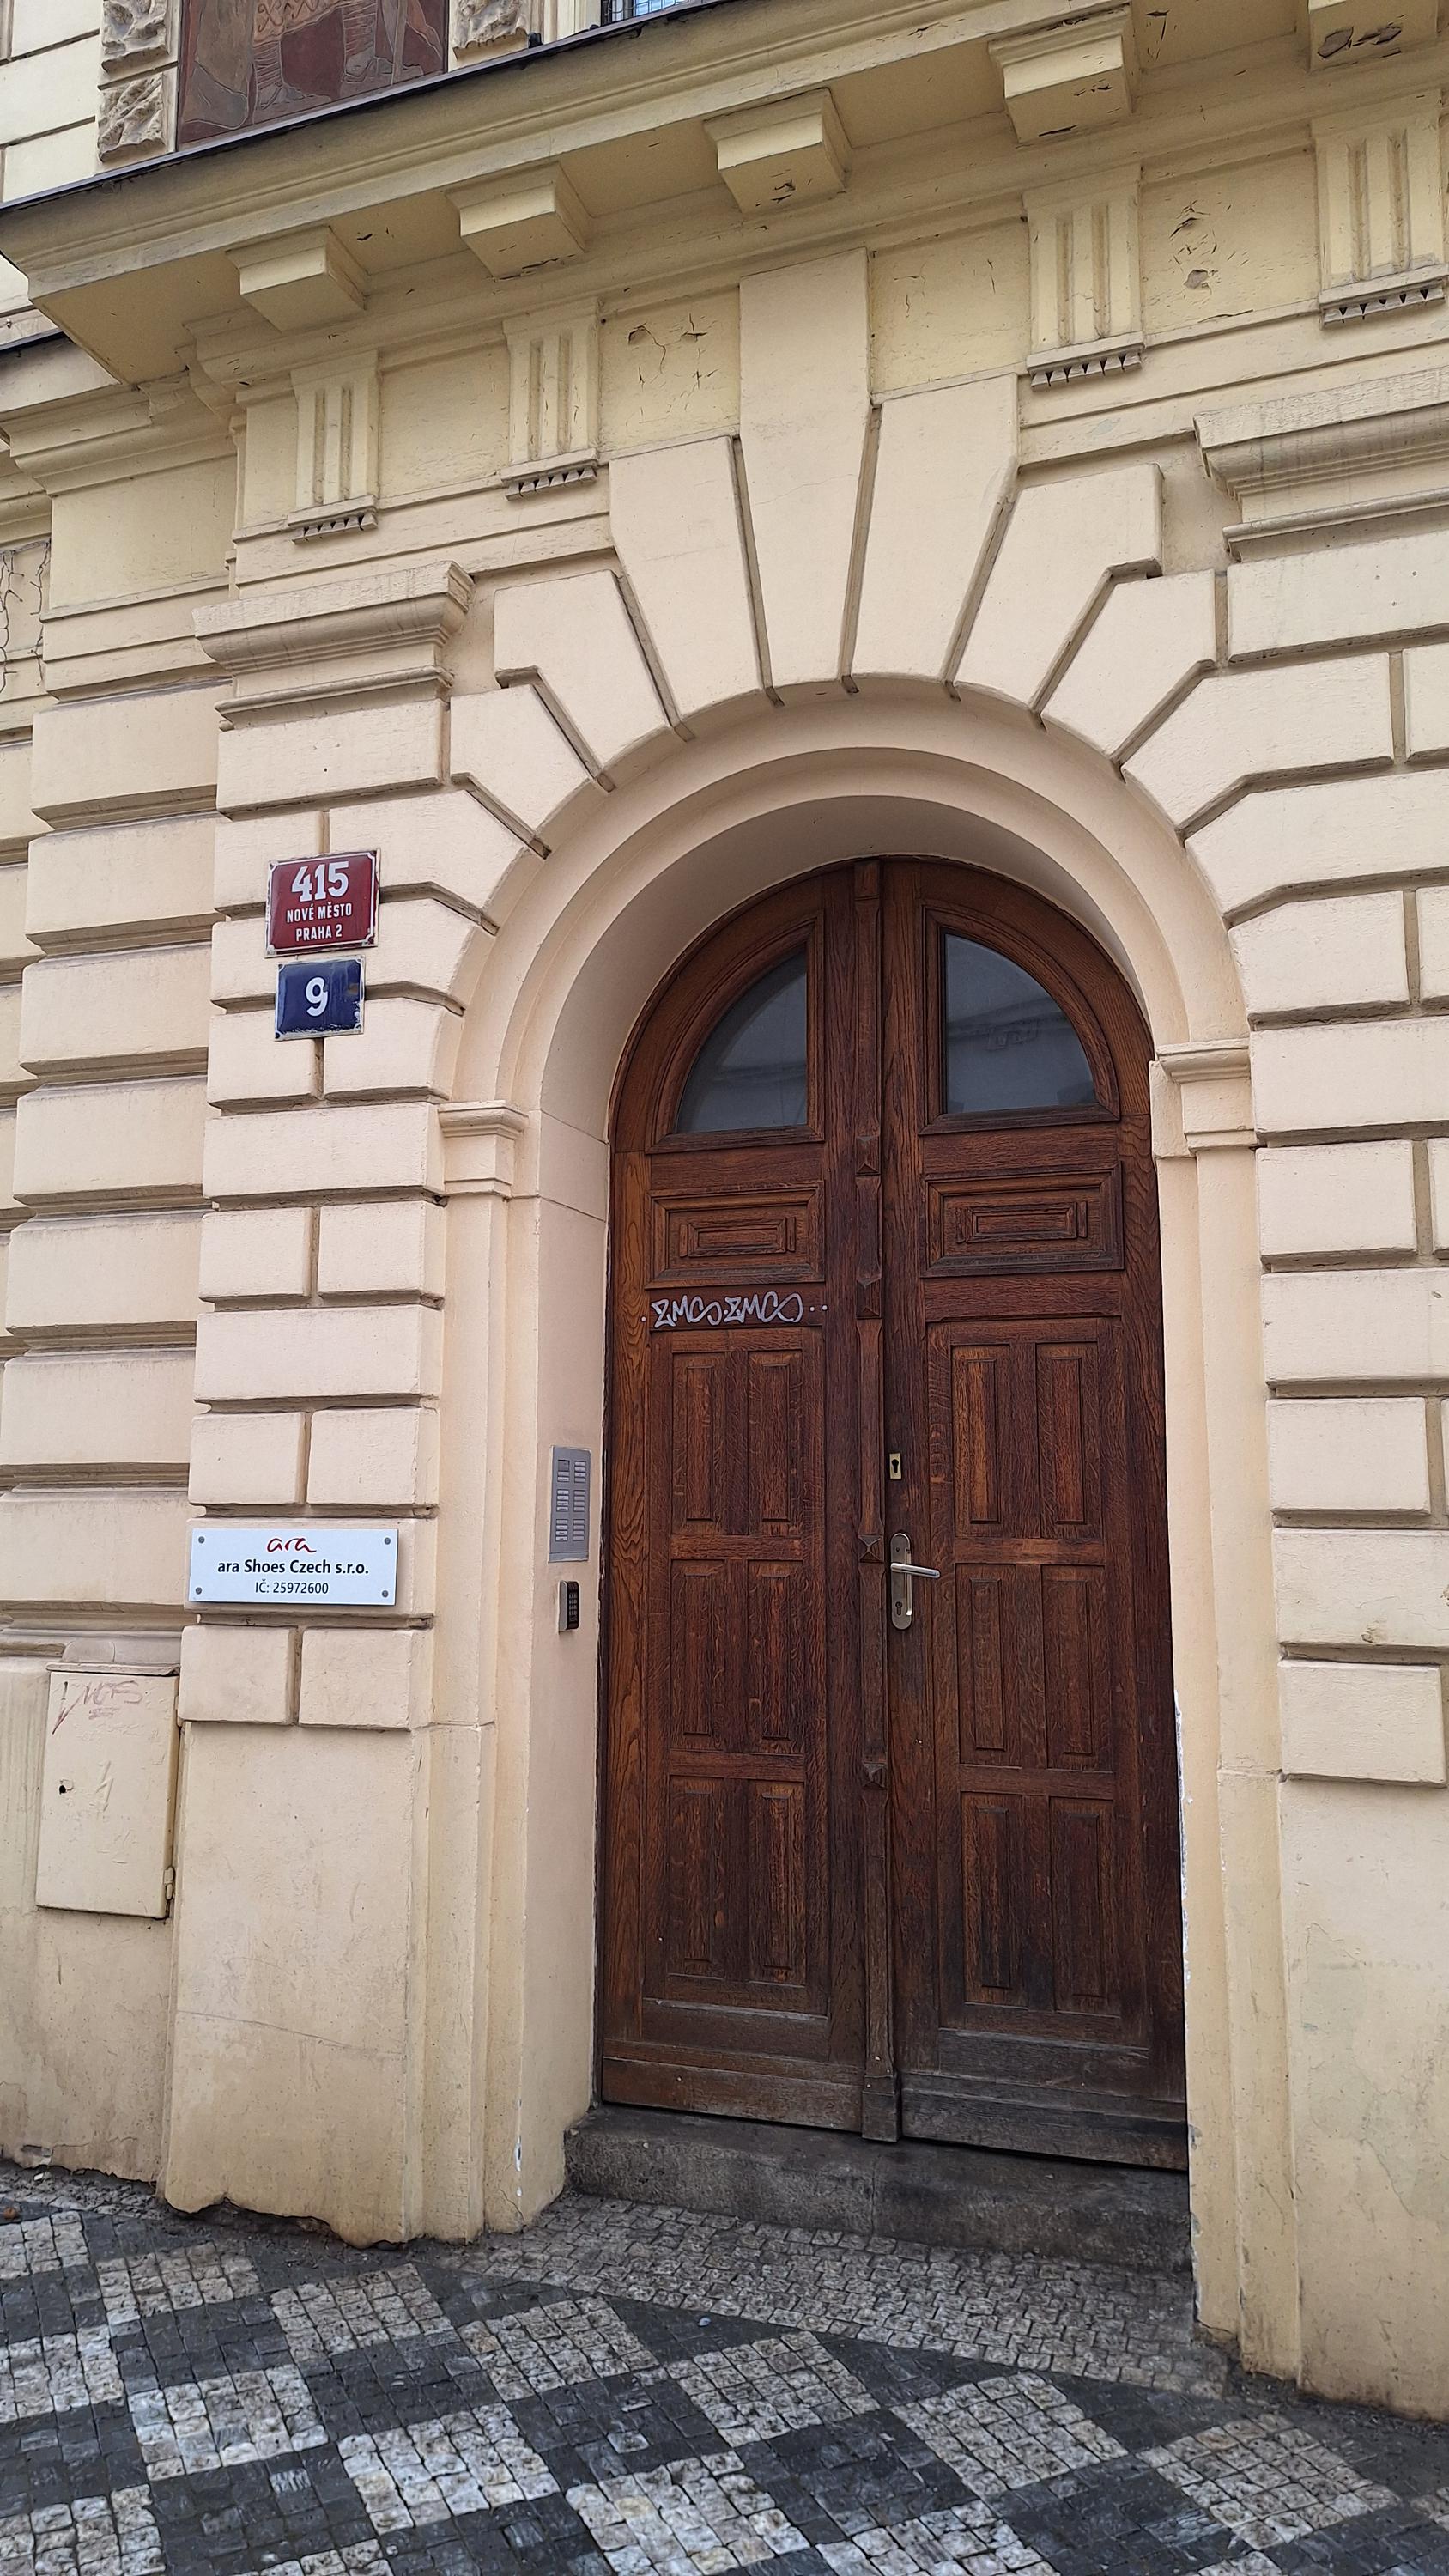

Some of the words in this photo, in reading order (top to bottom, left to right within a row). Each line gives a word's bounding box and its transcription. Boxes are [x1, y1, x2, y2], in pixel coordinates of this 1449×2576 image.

[291, 860, 349, 902] 415
[287, 903, 314, 923] NOVÉ
[318, 901, 353, 920] MĚSTO
[295, 925, 332, 942] PRAHA
[335, 924, 343, 938] 2
[305, 976, 329, 1017] 9
[266, 1537, 317, 1553] ara
[217, 1561, 239, 1573] ara
[244, 1558, 285, 1573] Shoes
[289, 1558, 331, 1574] Czech
[335, 1562, 369, 1575] s.r.o.
[255, 1578, 270, 1593] IČ:
[273, 1581, 330, 1595] 25972600
